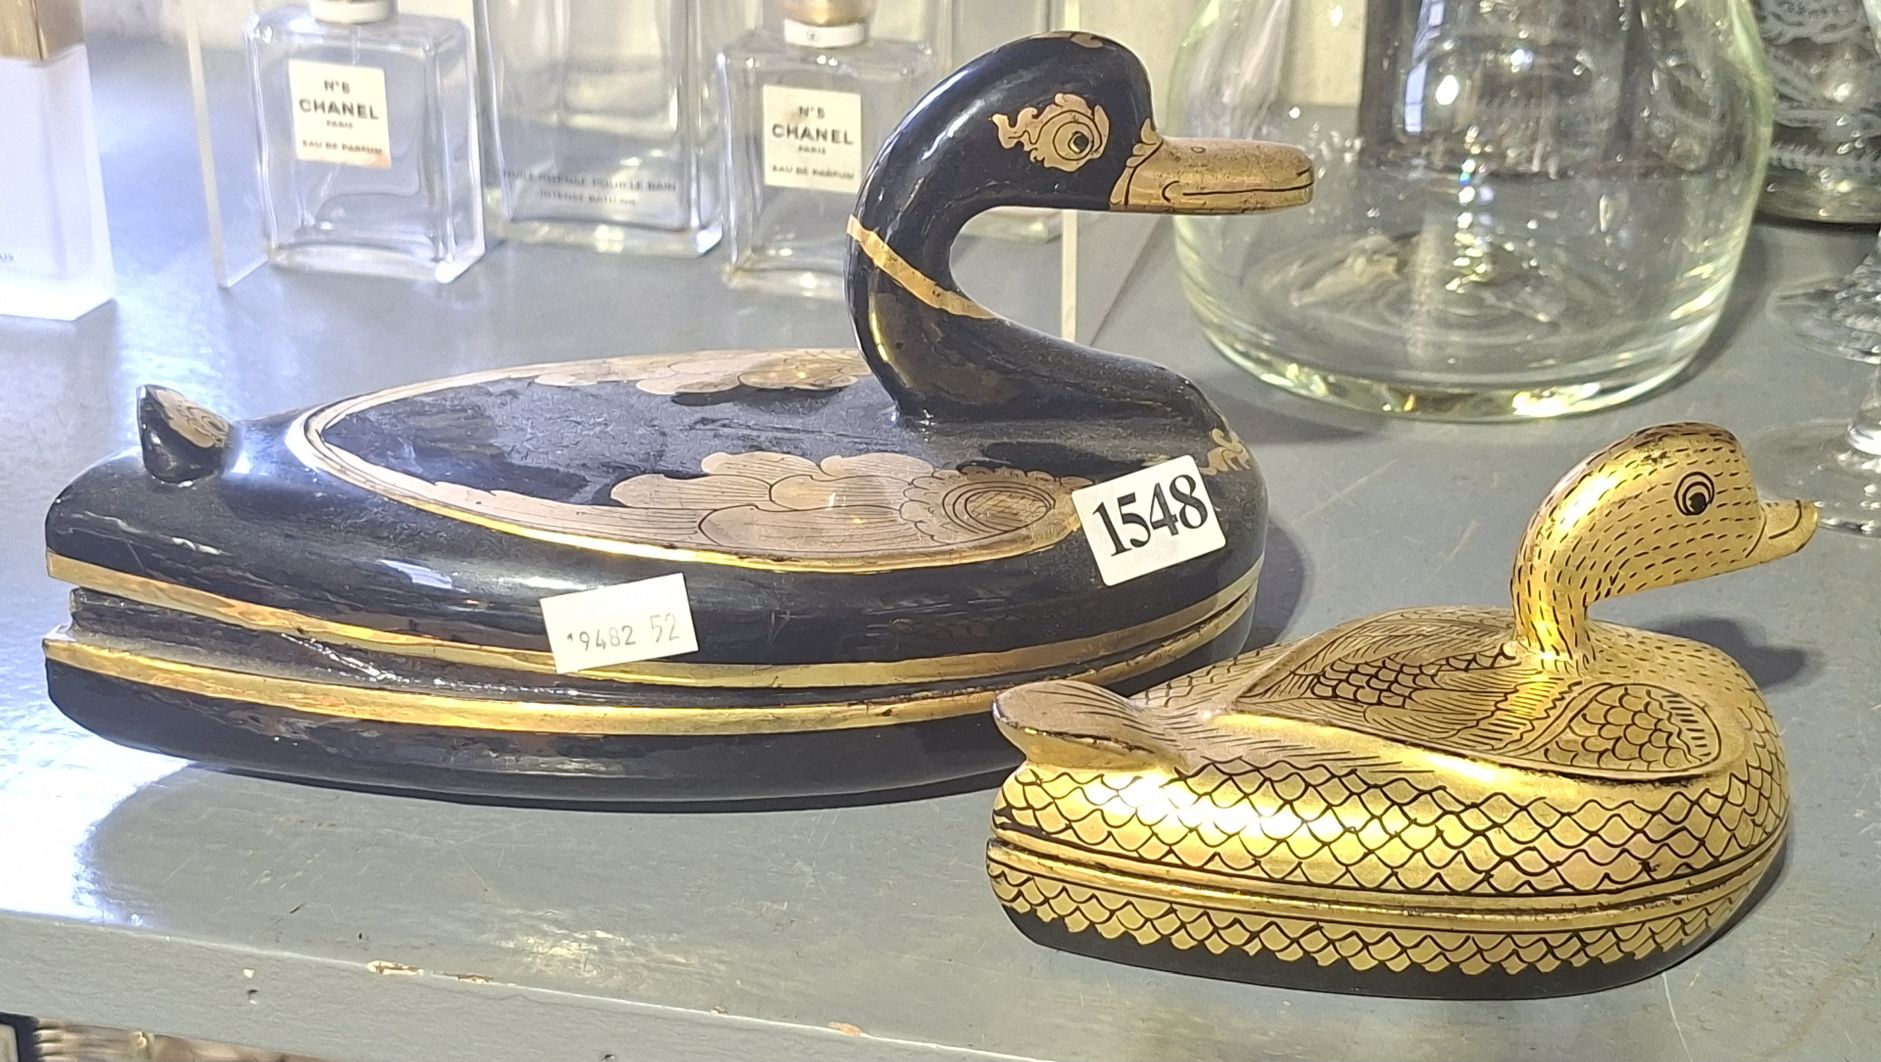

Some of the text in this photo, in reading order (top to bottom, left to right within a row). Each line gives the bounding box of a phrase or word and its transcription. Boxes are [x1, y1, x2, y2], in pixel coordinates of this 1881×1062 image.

[299, 98, 379, 120] CHANEL
[326, 119, 353, 129] PARIS
[772, 123, 854, 145] CHANEL
[798, 145, 826, 156] PARIS
[773, 164, 855, 181] EAU DE PARFUM
[1092, 474, 1208, 557] 1548
[650, 613, 680, 643] 52
